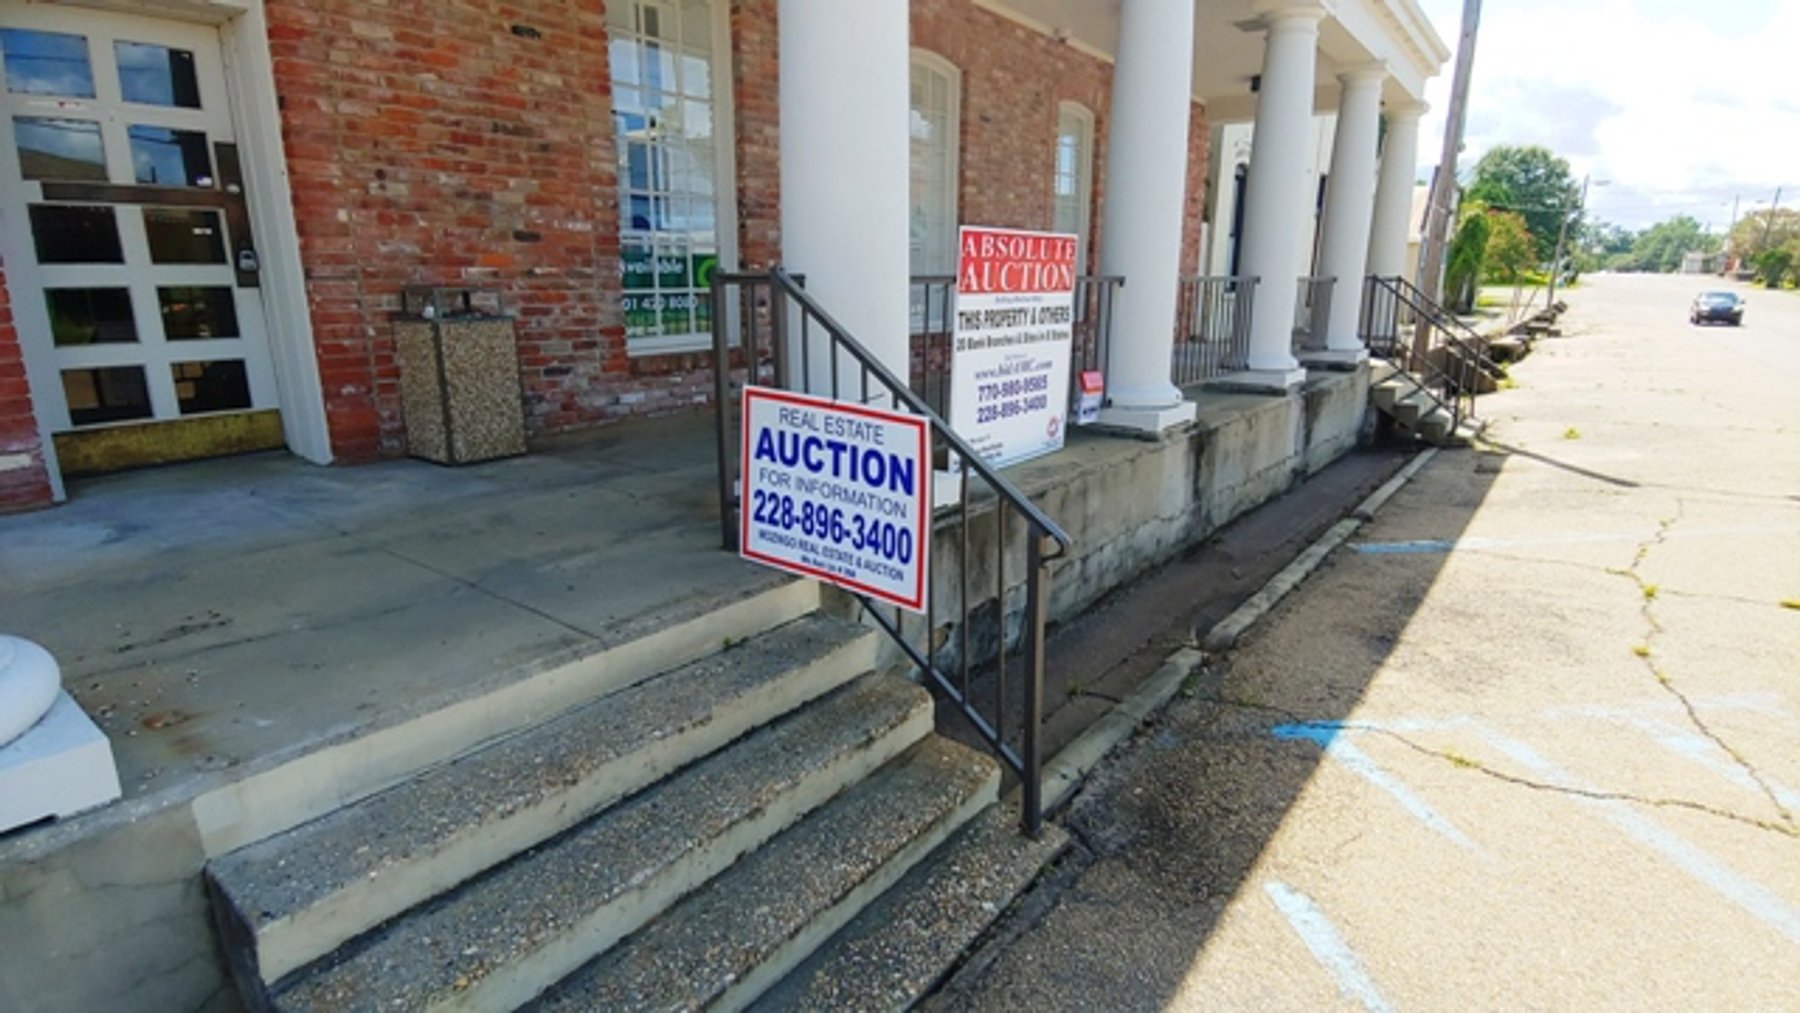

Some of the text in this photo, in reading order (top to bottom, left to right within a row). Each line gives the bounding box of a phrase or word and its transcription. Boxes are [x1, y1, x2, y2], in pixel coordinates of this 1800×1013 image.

[962, 234, 1075, 260] ABSOLUTE
[619, 257, 684, 275] vailable
[960, 261, 1073, 291] AUCTION
[958, 310, 980, 330] THIS
[984, 306, 1028, 328] PROPERTY
[1039, 304, 1070, 324] OTHERS
[976, 393, 1047, 423] 228-896-3400
[779, 407, 884, 445] REAL ESTATE
[755, 427, 914, 496] AUCTION
[759, 467, 906, 519] FOR INFORMATION
[753, 489, 913, 565] 228-896-3400
[799, 539, 820, 555] REAL
[822, 545, 854, 567] ESTATE
[863, 559, 904, 581] AUCTION
